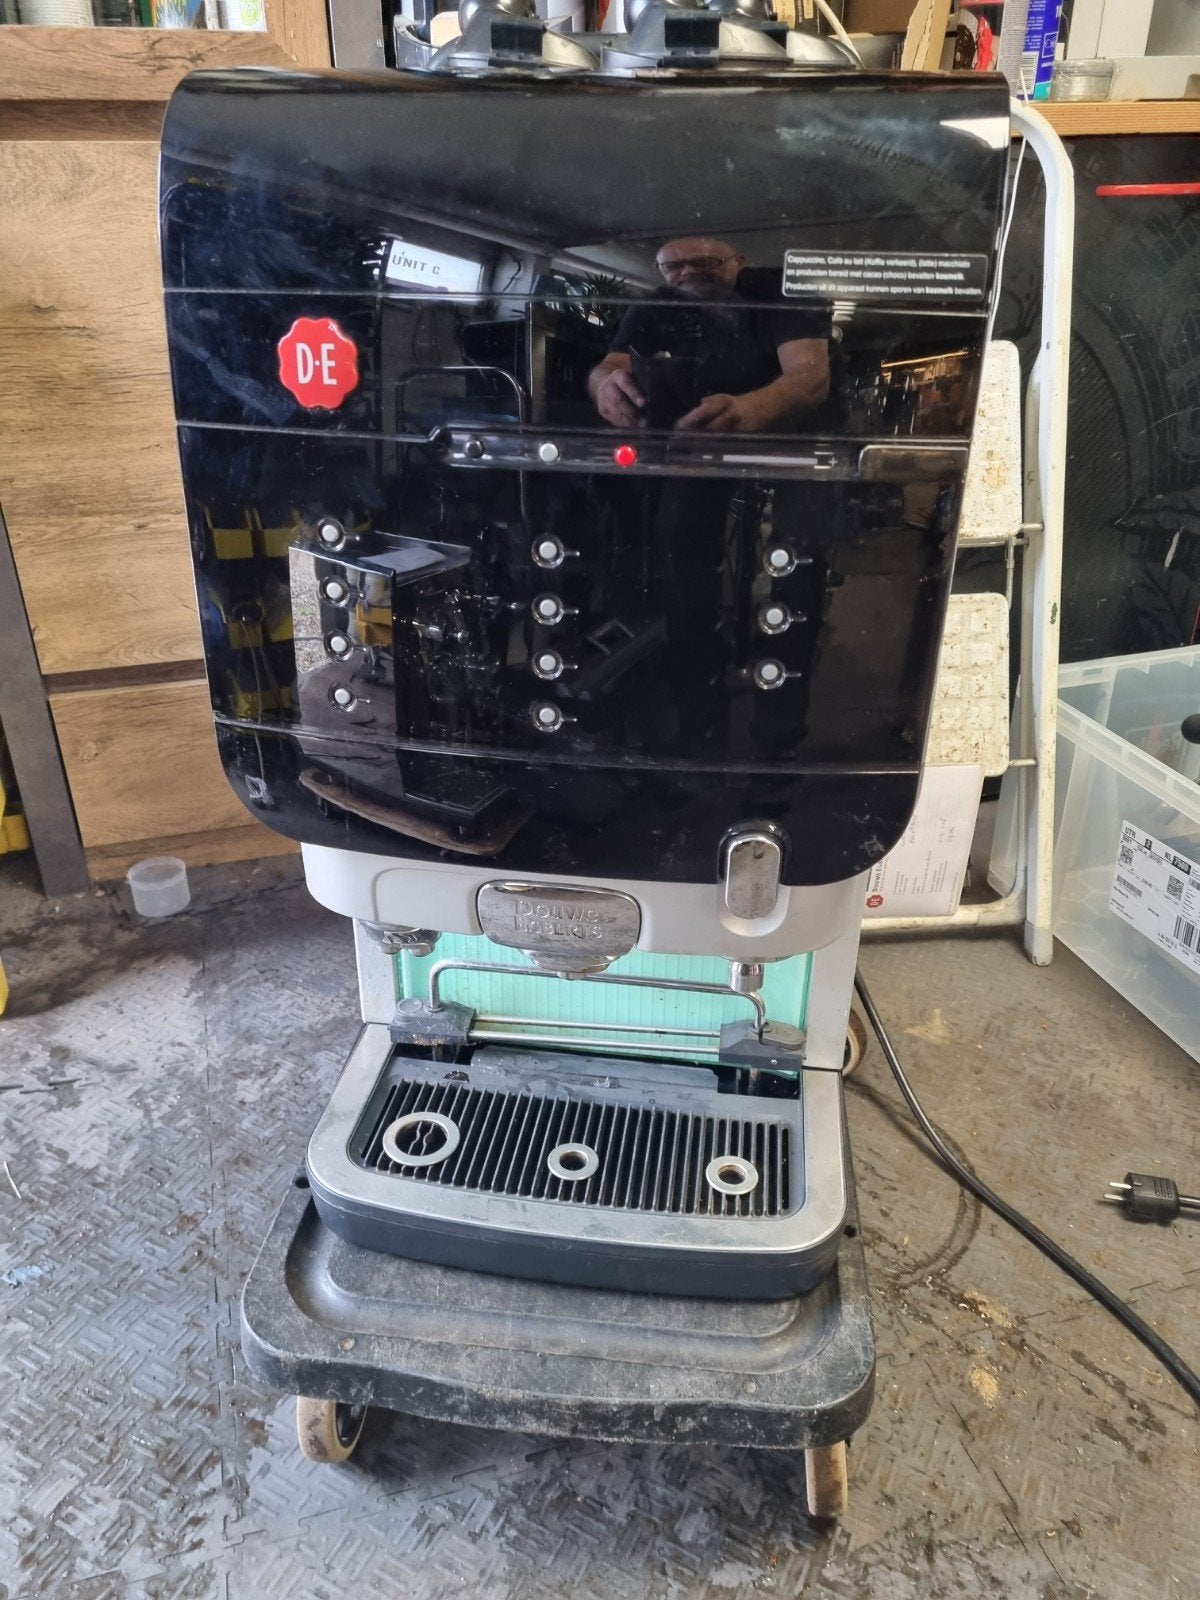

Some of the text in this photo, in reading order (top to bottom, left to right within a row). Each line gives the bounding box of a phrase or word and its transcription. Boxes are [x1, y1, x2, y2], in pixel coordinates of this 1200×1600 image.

[392, 254, 441, 275] UNIT C
[843, 257, 853, 265] au
[795, 268, 828, 277] producten
[828, 269, 849, 277] bereid
[849, 270, 862, 278] met
[862, 271, 882, 279] cacao
[785, 281, 818, 290] Producten
[865, 285, 889, 293] kunnen
[890, 286, 912, 295] sporen
